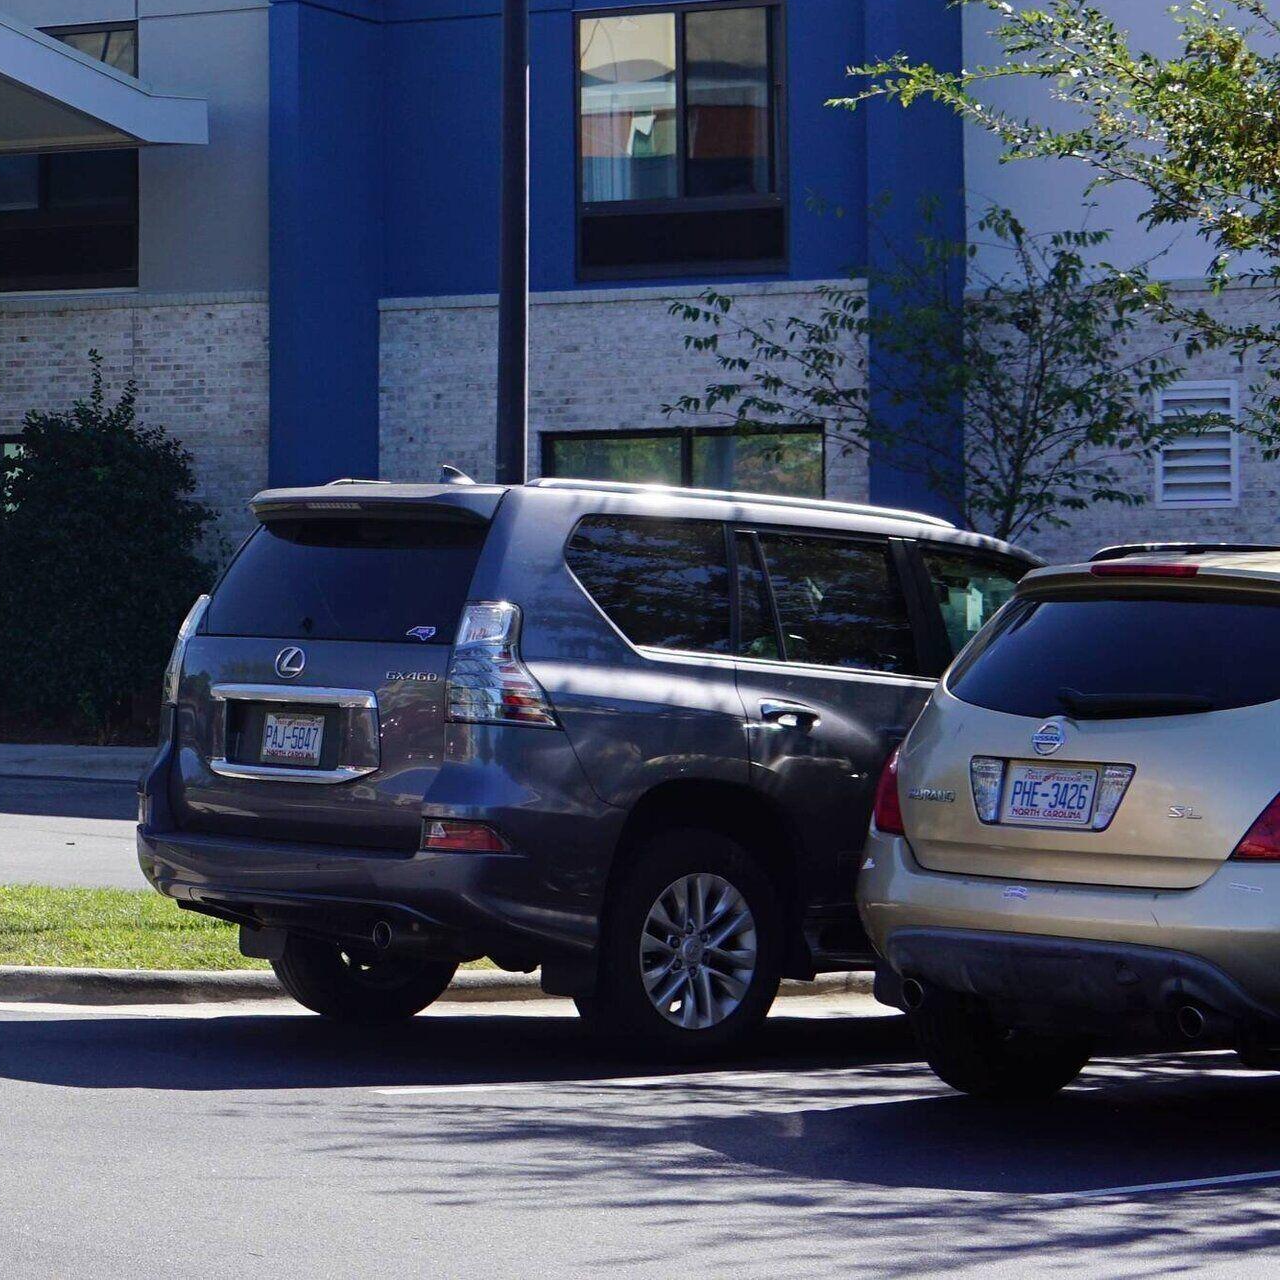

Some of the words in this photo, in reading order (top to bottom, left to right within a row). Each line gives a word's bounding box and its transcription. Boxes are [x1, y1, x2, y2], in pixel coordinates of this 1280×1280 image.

[265, 725, 319, 750] PAJ-5847
[1011, 781, 1088, 810] PHE-3426
[1012, 808, 1039, 817] NORTH
[1042, 809, 1081, 819] CAROLINA
[1168, 805, 1202, 819] SL
